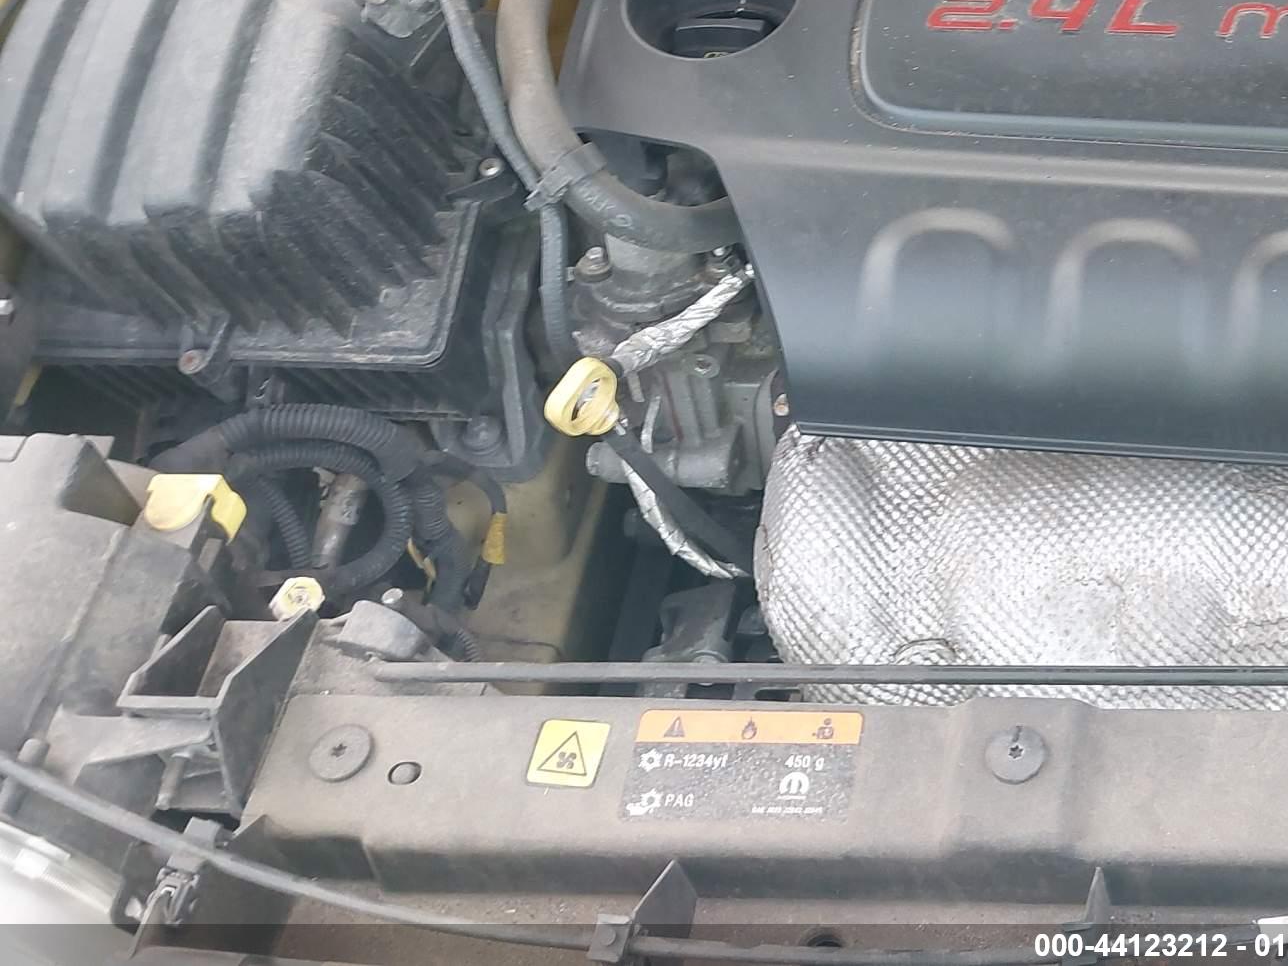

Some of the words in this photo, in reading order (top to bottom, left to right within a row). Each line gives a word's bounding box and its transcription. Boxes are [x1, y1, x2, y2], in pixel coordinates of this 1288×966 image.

[663, 753, 728, 771] R-1234yf
[784, 754, 810, 769] 450
[814, 757, 825, 771] g
[664, 793, 695, 808] PAG
